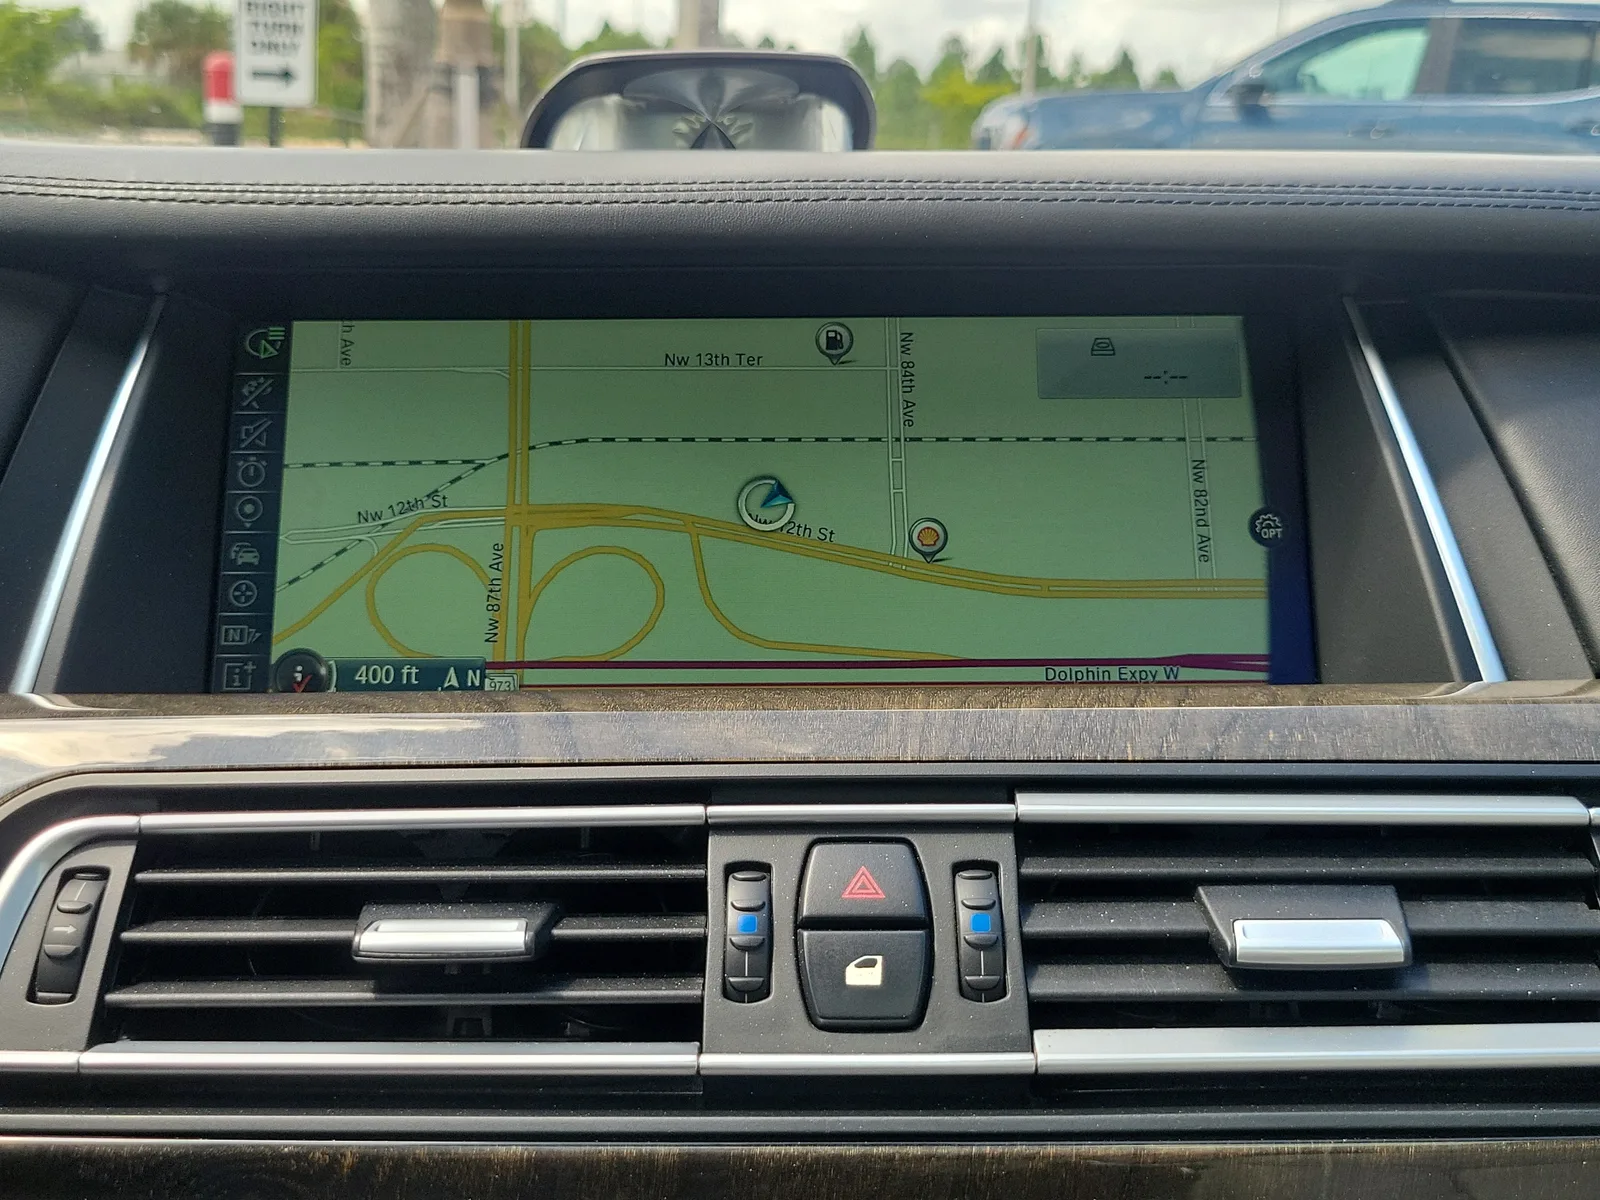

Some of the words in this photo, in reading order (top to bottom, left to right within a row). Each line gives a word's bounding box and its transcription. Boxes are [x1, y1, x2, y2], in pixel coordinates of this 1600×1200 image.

[340, 338, 355, 366] Ave
[899, 332, 914, 356] Nw
[664, 353, 689, 366] Nw
[696, 352, 730, 366] 13th
[736, 353, 763, 366] Ter
[900, 360, 916, 394] 84th
[901, 399, 916, 428] Ave
[1191, 459, 1206, 484] Nw
[357, 510, 384, 523] Nw
[388, 497, 425, 517] 12th
[431, 494, 449, 508] St
[1193, 489, 1210, 528] 82nd
[816, 527, 836, 543] St
[489, 543, 504, 573] Ave
[1197, 533, 1211, 563] Ave
[486, 578, 502, 613] 87th
[484, 618, 499, 643] Nw
[355, 665, 395, 684] 400
[401, 665, 420, 684] ft
[467, 669, 481, 687] N
[489, 679, 511, 691] 973
[1045, 667, 1111, 683] Dolphin
[1118, 667, 1158, 683] Expy
[1163, 666, 1180, 680] W
